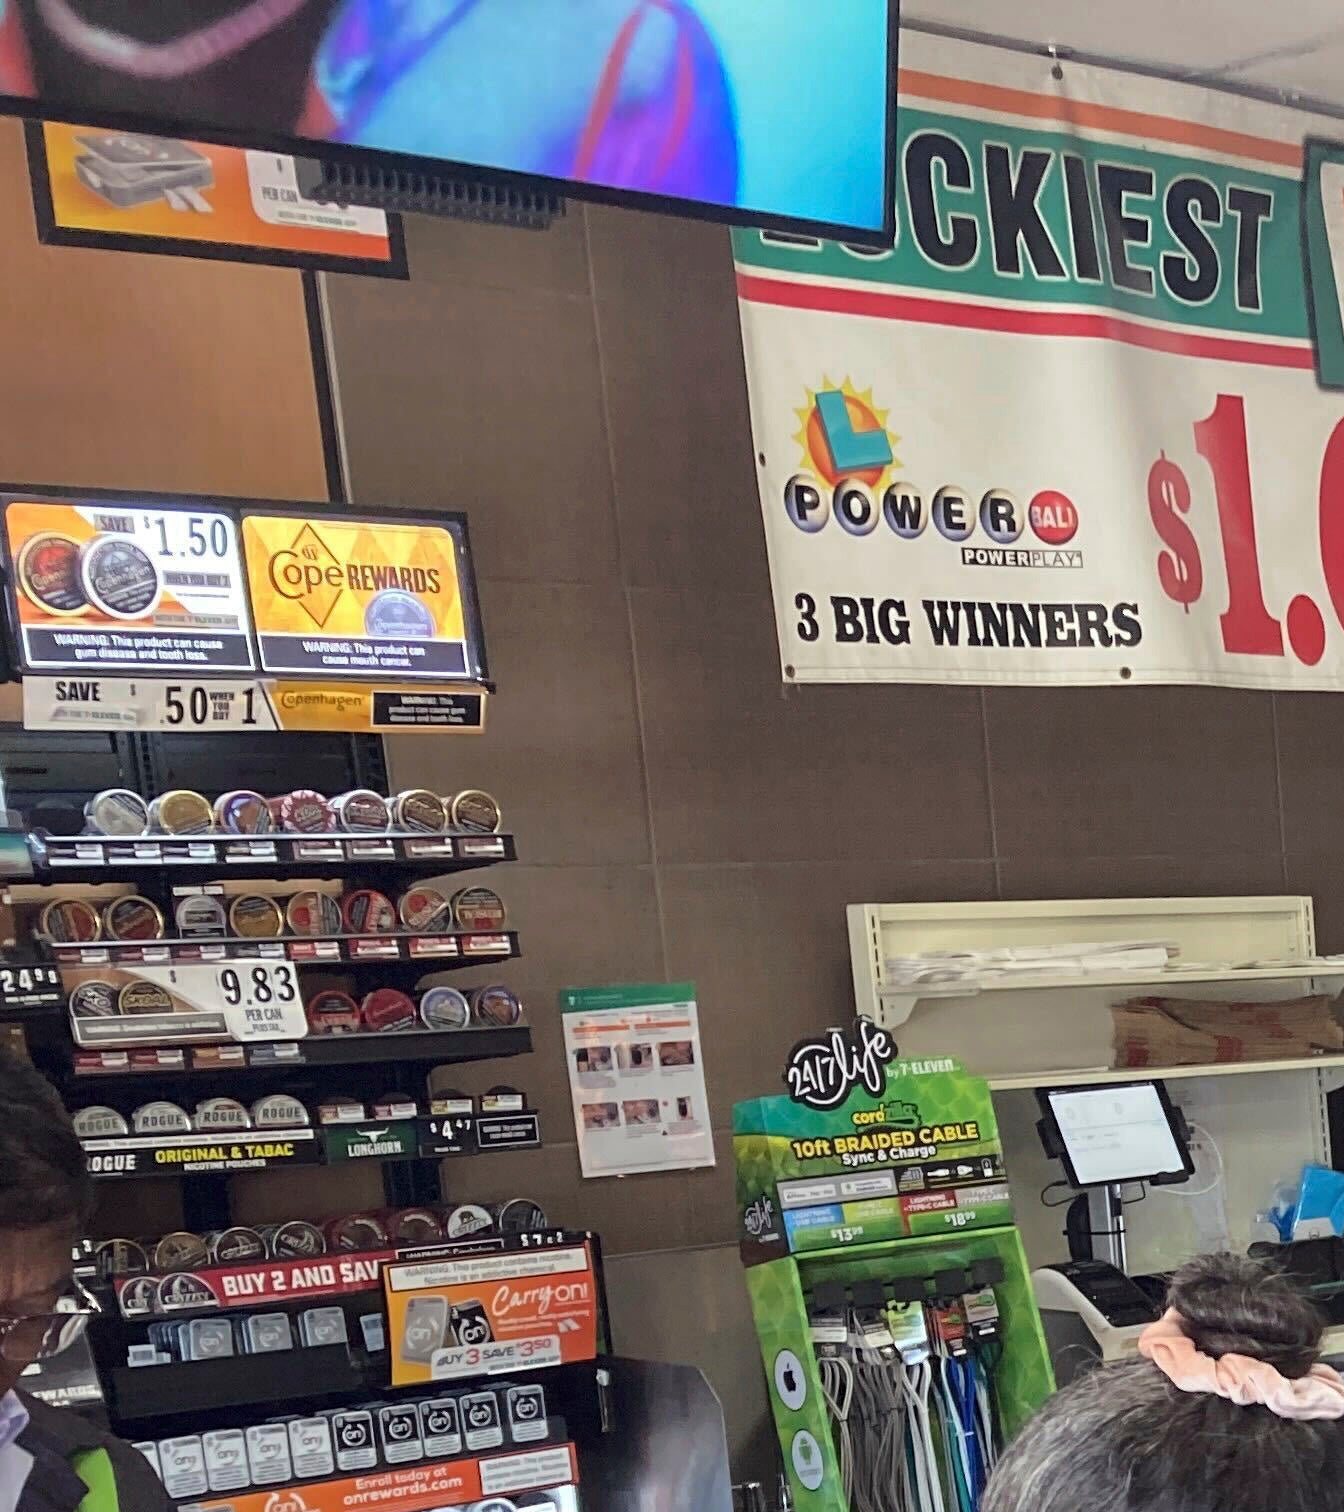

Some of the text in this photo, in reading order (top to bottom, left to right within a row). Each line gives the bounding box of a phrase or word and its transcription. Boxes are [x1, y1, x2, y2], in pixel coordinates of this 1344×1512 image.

[760, 130, 1273, 312] CKIEST
[100, 515, 130, 533] SAVE
[268, 549, 441, 600] Cope REWARDS
[796, 593, 1143, 649] 3 BIG WINNERS
[55, 681, 101, 702] SAVE
[281, 690, 362, 711] Copenhagen
[221, 966, 295, 1005] 9.83
[245, 1009, 282, 1021] PER CAN
[78, 1117, 119, 1131] ROGUE
[142, 1113, 184, 1127] ROGUE
[203, 1109, 244, 1123] ROGUE
[262, 1106, 302, 1120] ROGUE
[347, 1140, 402, 1157] LONGHORN
[791, 1123, 979, 1160] 10ft BRAIDED CABLE
[155, 1142, 295, 1164] ORIGINAL & TABAC
[842, 1145, 937, 1167] Sync & Charge
[222, 1266, 335, 1297] BUY 2 AND
[491, 1284, 553, 1316] Carry
[436, 1351, 463, 1367] BUY
[466, 1348, 480, 1365] 3
[482, 1346, 516, 1360] SAVE
[355, 1465, 448, 1490] Enroll today at
[343, 1476, 464, 1506] onrewards.com
